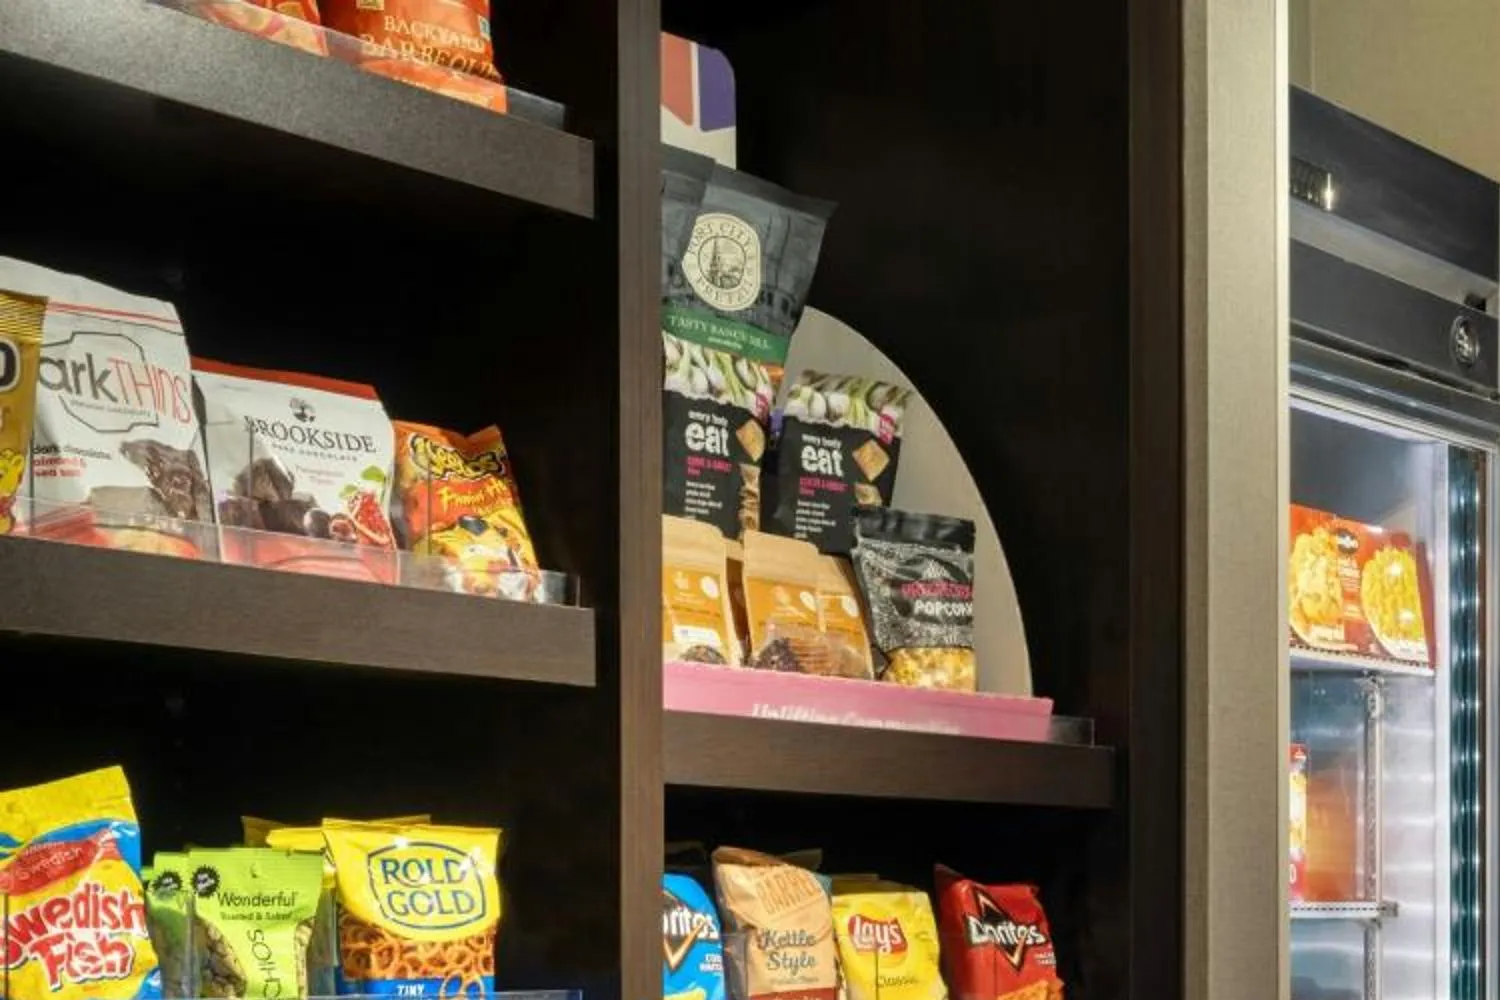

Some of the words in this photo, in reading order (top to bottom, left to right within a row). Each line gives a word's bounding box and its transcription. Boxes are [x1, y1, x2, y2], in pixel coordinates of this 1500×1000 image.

[244, 415, 376, 453] BROOKSIDE
[685, 422, 729, 456] eat
[801, 445, 844, 477] eat
[380, 858, 466, 886] ROLD
[218, 890, 296, 907] Wonderful
[386, 889, 475, 917] GOLD
[966, 914, 1047, 946] Doritos
[28, 929, 135, 991] Fish
[767, 951, 817, 975] Style
[396, 983, 424, 997] TINY
